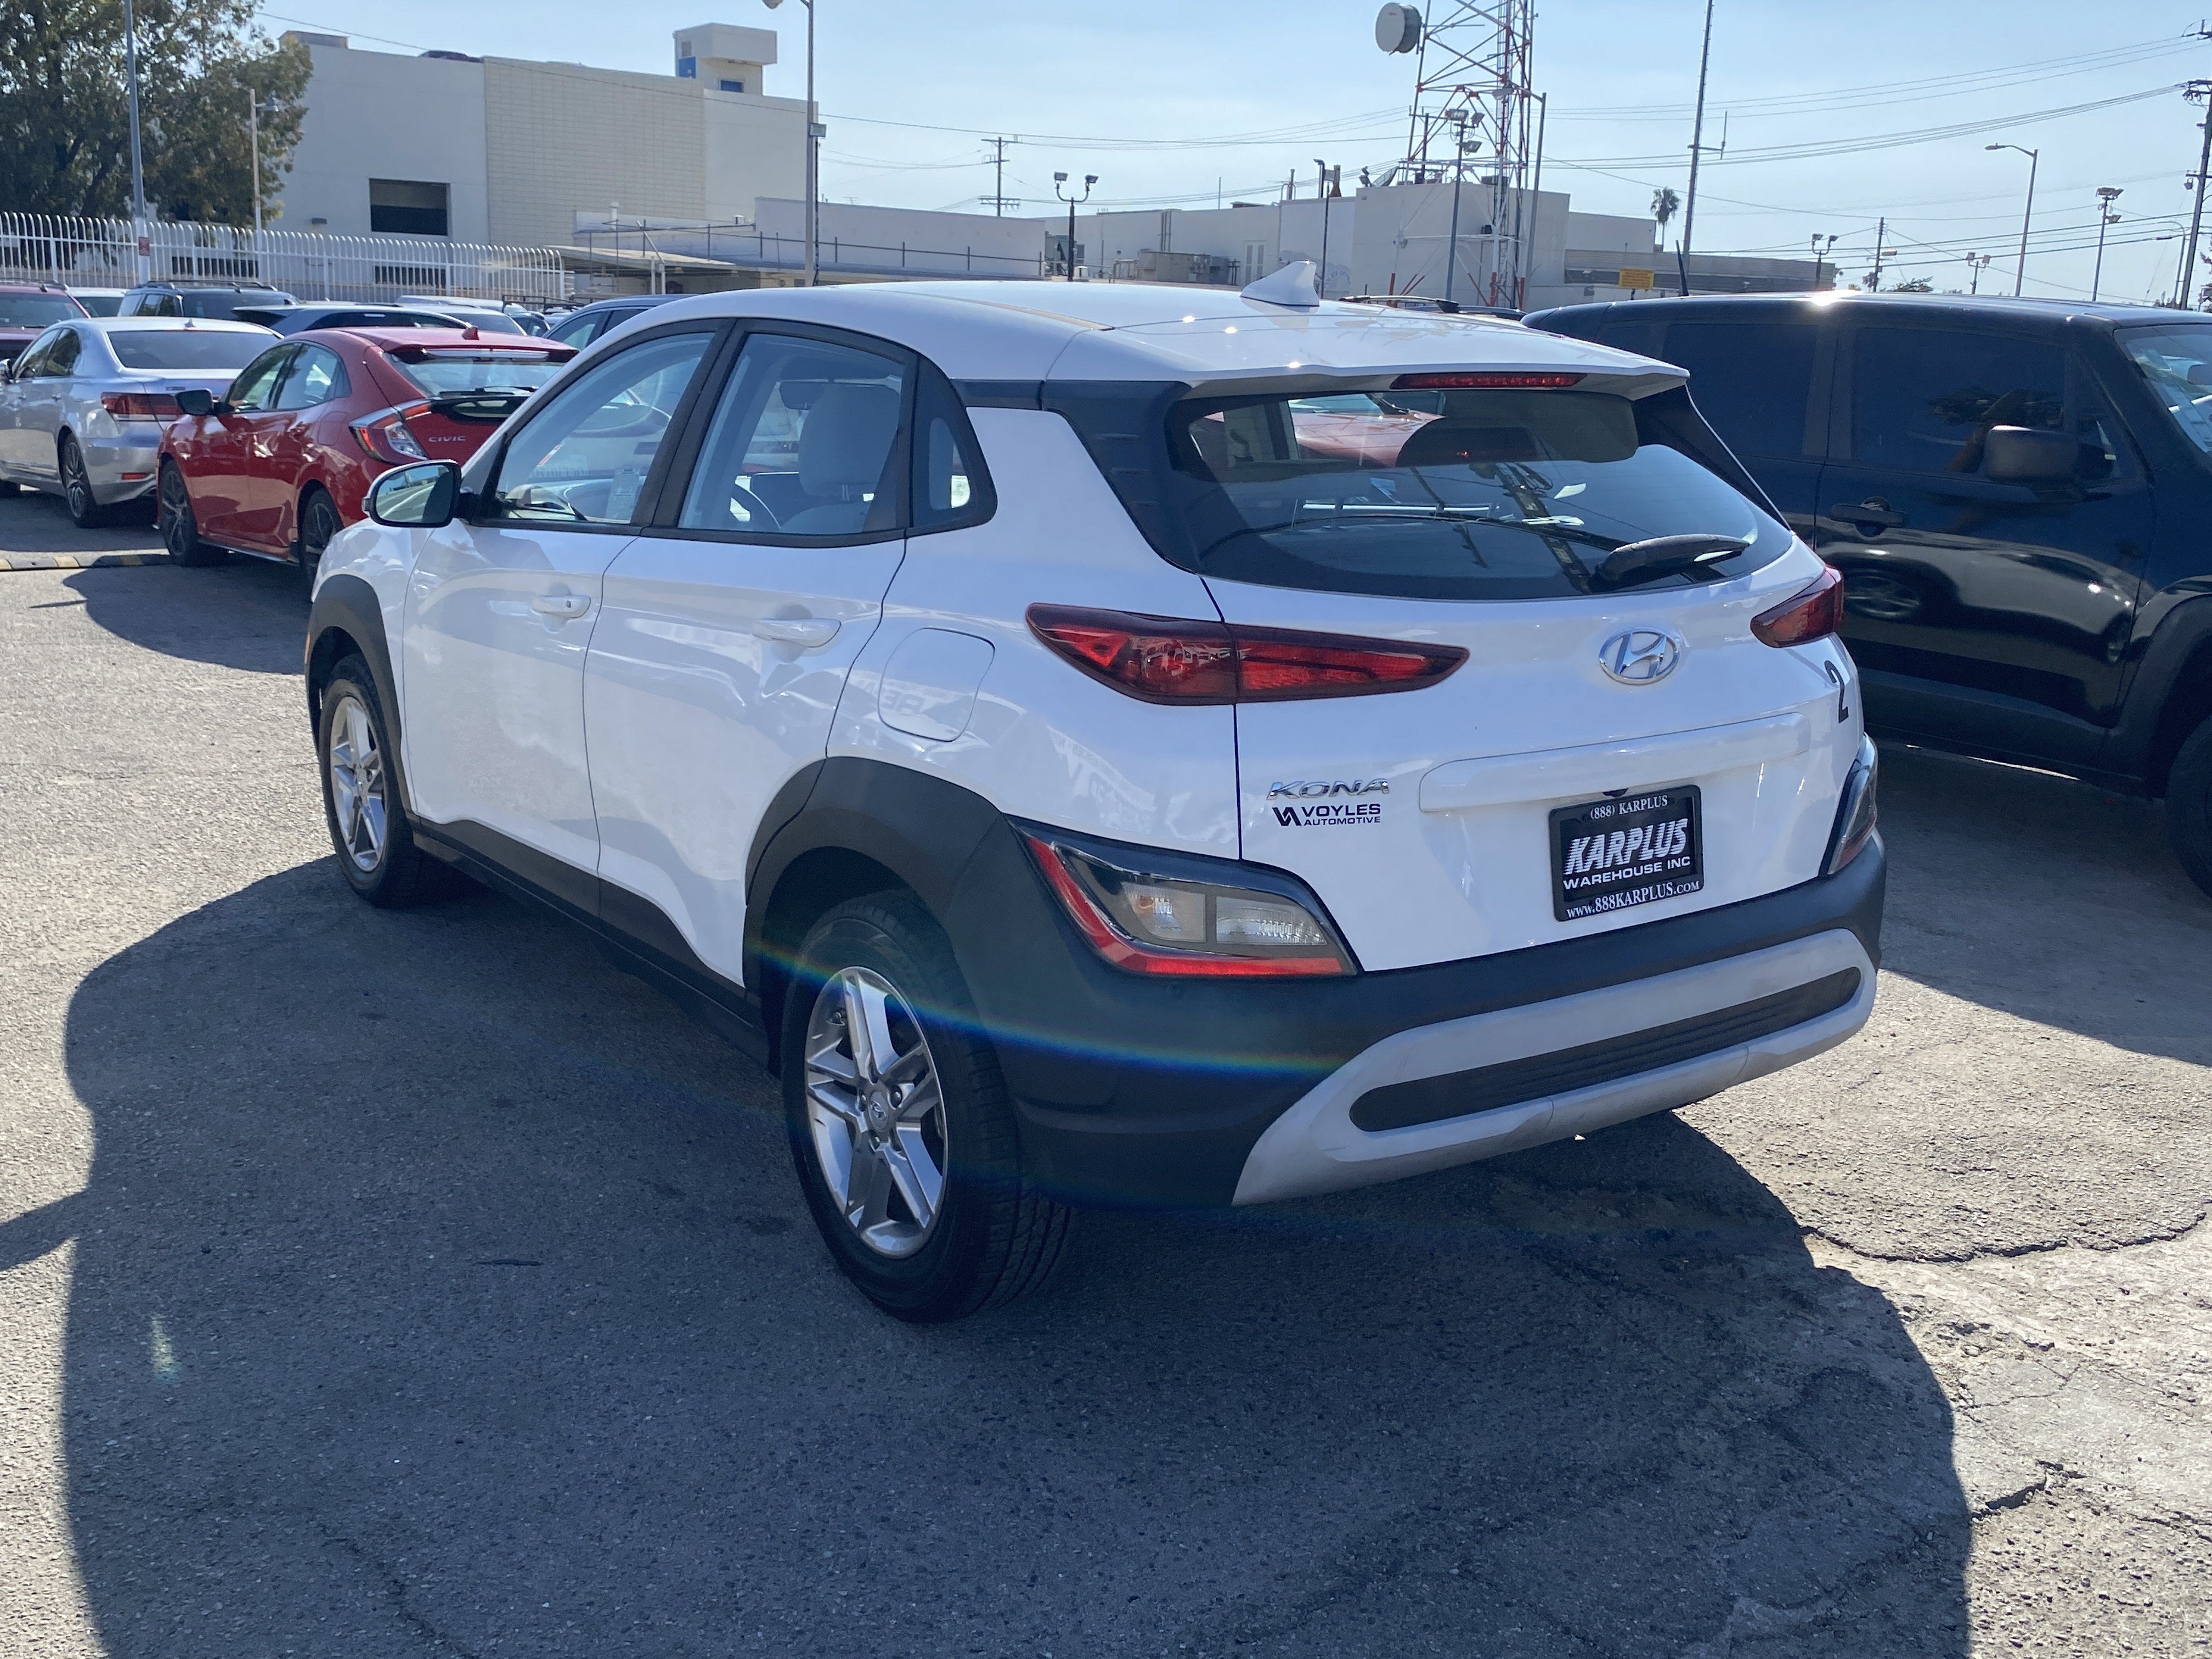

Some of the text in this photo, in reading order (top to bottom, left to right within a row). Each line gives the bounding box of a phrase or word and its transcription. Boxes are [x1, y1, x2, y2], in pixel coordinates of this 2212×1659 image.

[1824, 660, 1849, 724] 2
[1266, 778, 1391, 800] KONA
[1301, 803, 1381, 817] VOYLES
[1590, 795, 1668, 820] (888) KARPLUS
[1304, 816, 1381, 826] AUTOMOTIVE
[1564, 818, 1688, 875] KARPLUS
[1563, 856, 1690, 890] WAREHOUSE INC
